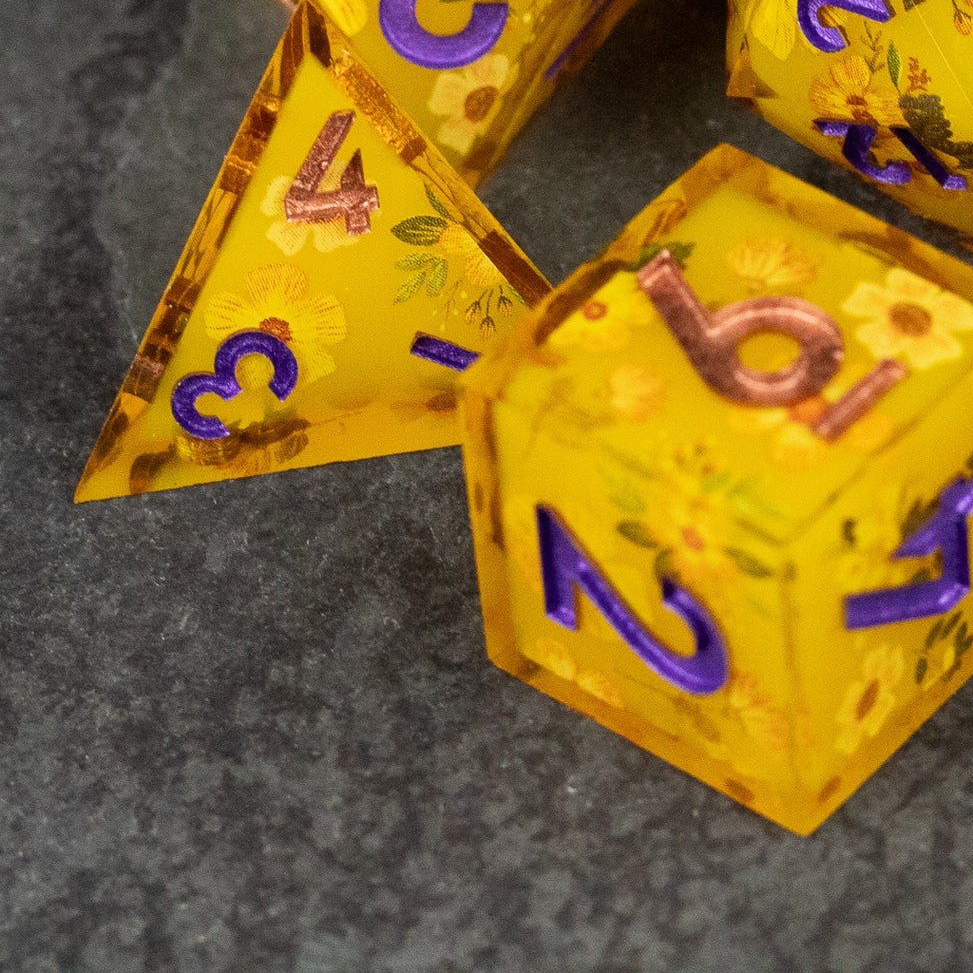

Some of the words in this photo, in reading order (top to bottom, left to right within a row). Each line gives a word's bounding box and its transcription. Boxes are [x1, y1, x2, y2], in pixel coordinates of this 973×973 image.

[285, 109, 381, 235] 4
[813, 120, 967, 191] 12
[171, 331, 299, 441] 3
[638, 249, 910, 442] 6
[535, 504, 730, 696] 2
